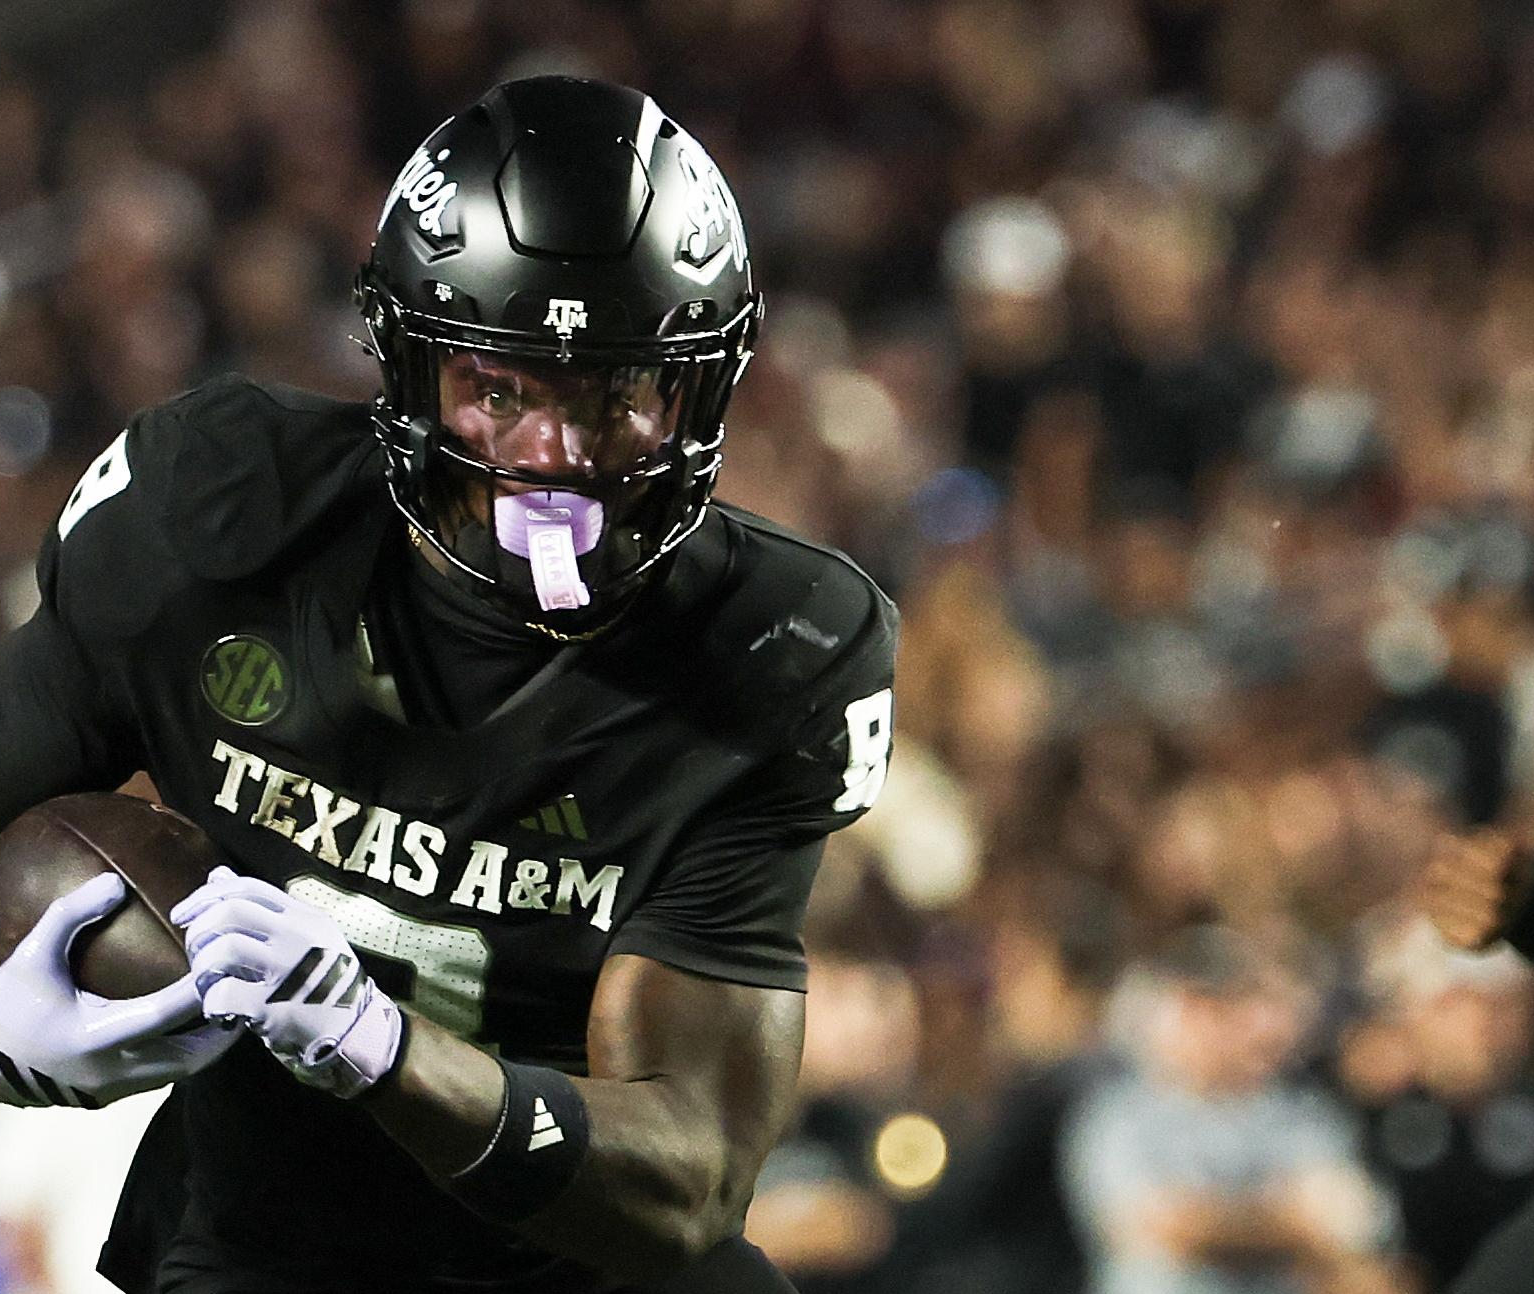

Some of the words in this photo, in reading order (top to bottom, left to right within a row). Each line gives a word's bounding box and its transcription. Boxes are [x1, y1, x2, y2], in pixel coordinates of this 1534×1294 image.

[58, 429, 132, 542] 8
[205, 640, 284, 722] SEC
[833, 687, 893, 813] 8
[212, 739, 448, 897] TEXAS
[449, 840, 625, 932] A&M
